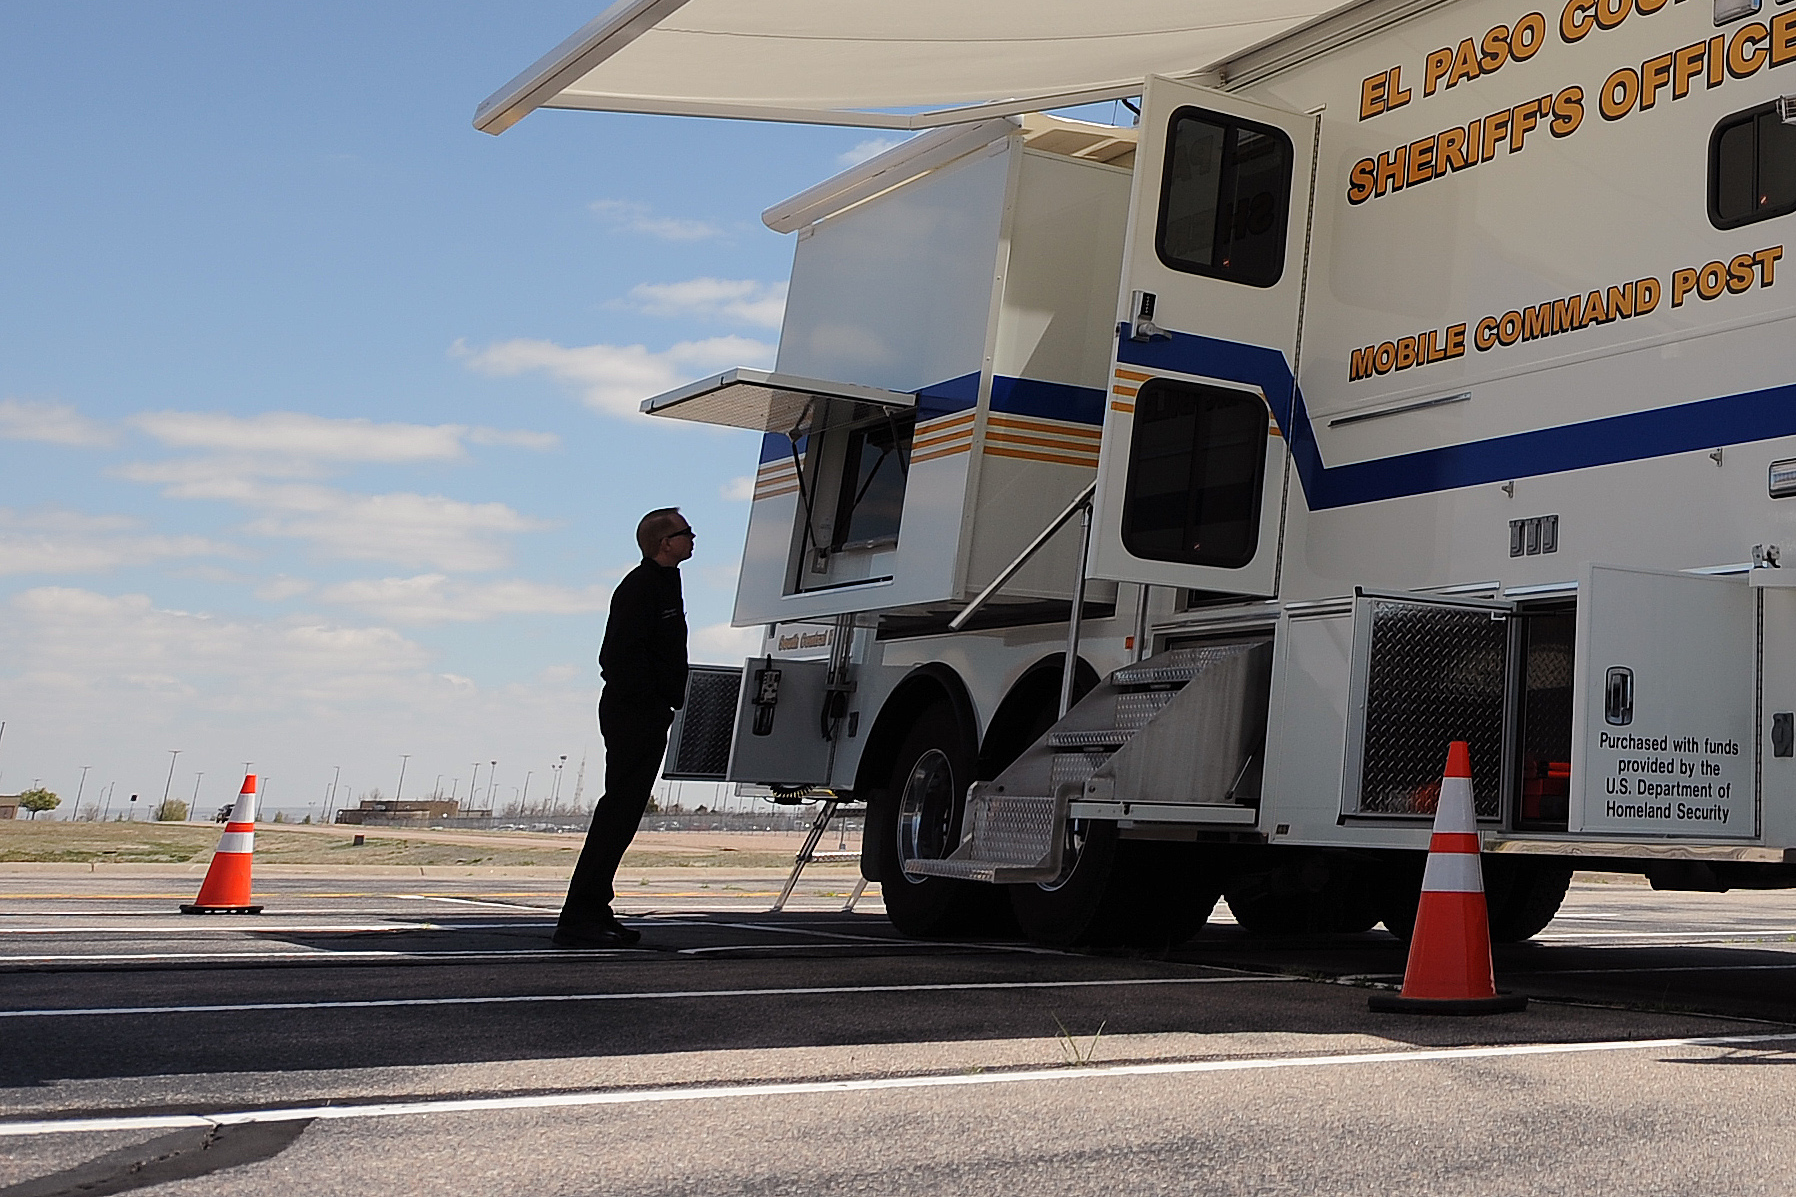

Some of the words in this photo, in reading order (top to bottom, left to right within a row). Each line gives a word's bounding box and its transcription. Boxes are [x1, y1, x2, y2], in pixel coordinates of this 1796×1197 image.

[1359, 66, 1412, 121] EL
[1424, 13, 1546, 96] PASO
[1348, 86, 1585, 205] SHERIFF'S
[1349, 323, 1465, 381] MOBILE
[1475, 278, 1660, 349] COMMAND
[1672, 246, 1783, 306] POST
[1599, 731, 1667, 752] Purchased
[1673, 736, 1699, 754] with
[1704, 738, 1739, 756] funds
[1618, 757, 1674, 775] provided
[1679, 759, 1695, 778] by
[1700, 760, 1721, 776] the
[1606, 777, 1632, 795] U.S.
[1637, 778, 1712, 799] Department
[1717, 782, 1731, 799] of
[1606, 800, 1671, 819] Homeland
[1676, 803, 1730, 824] Security
